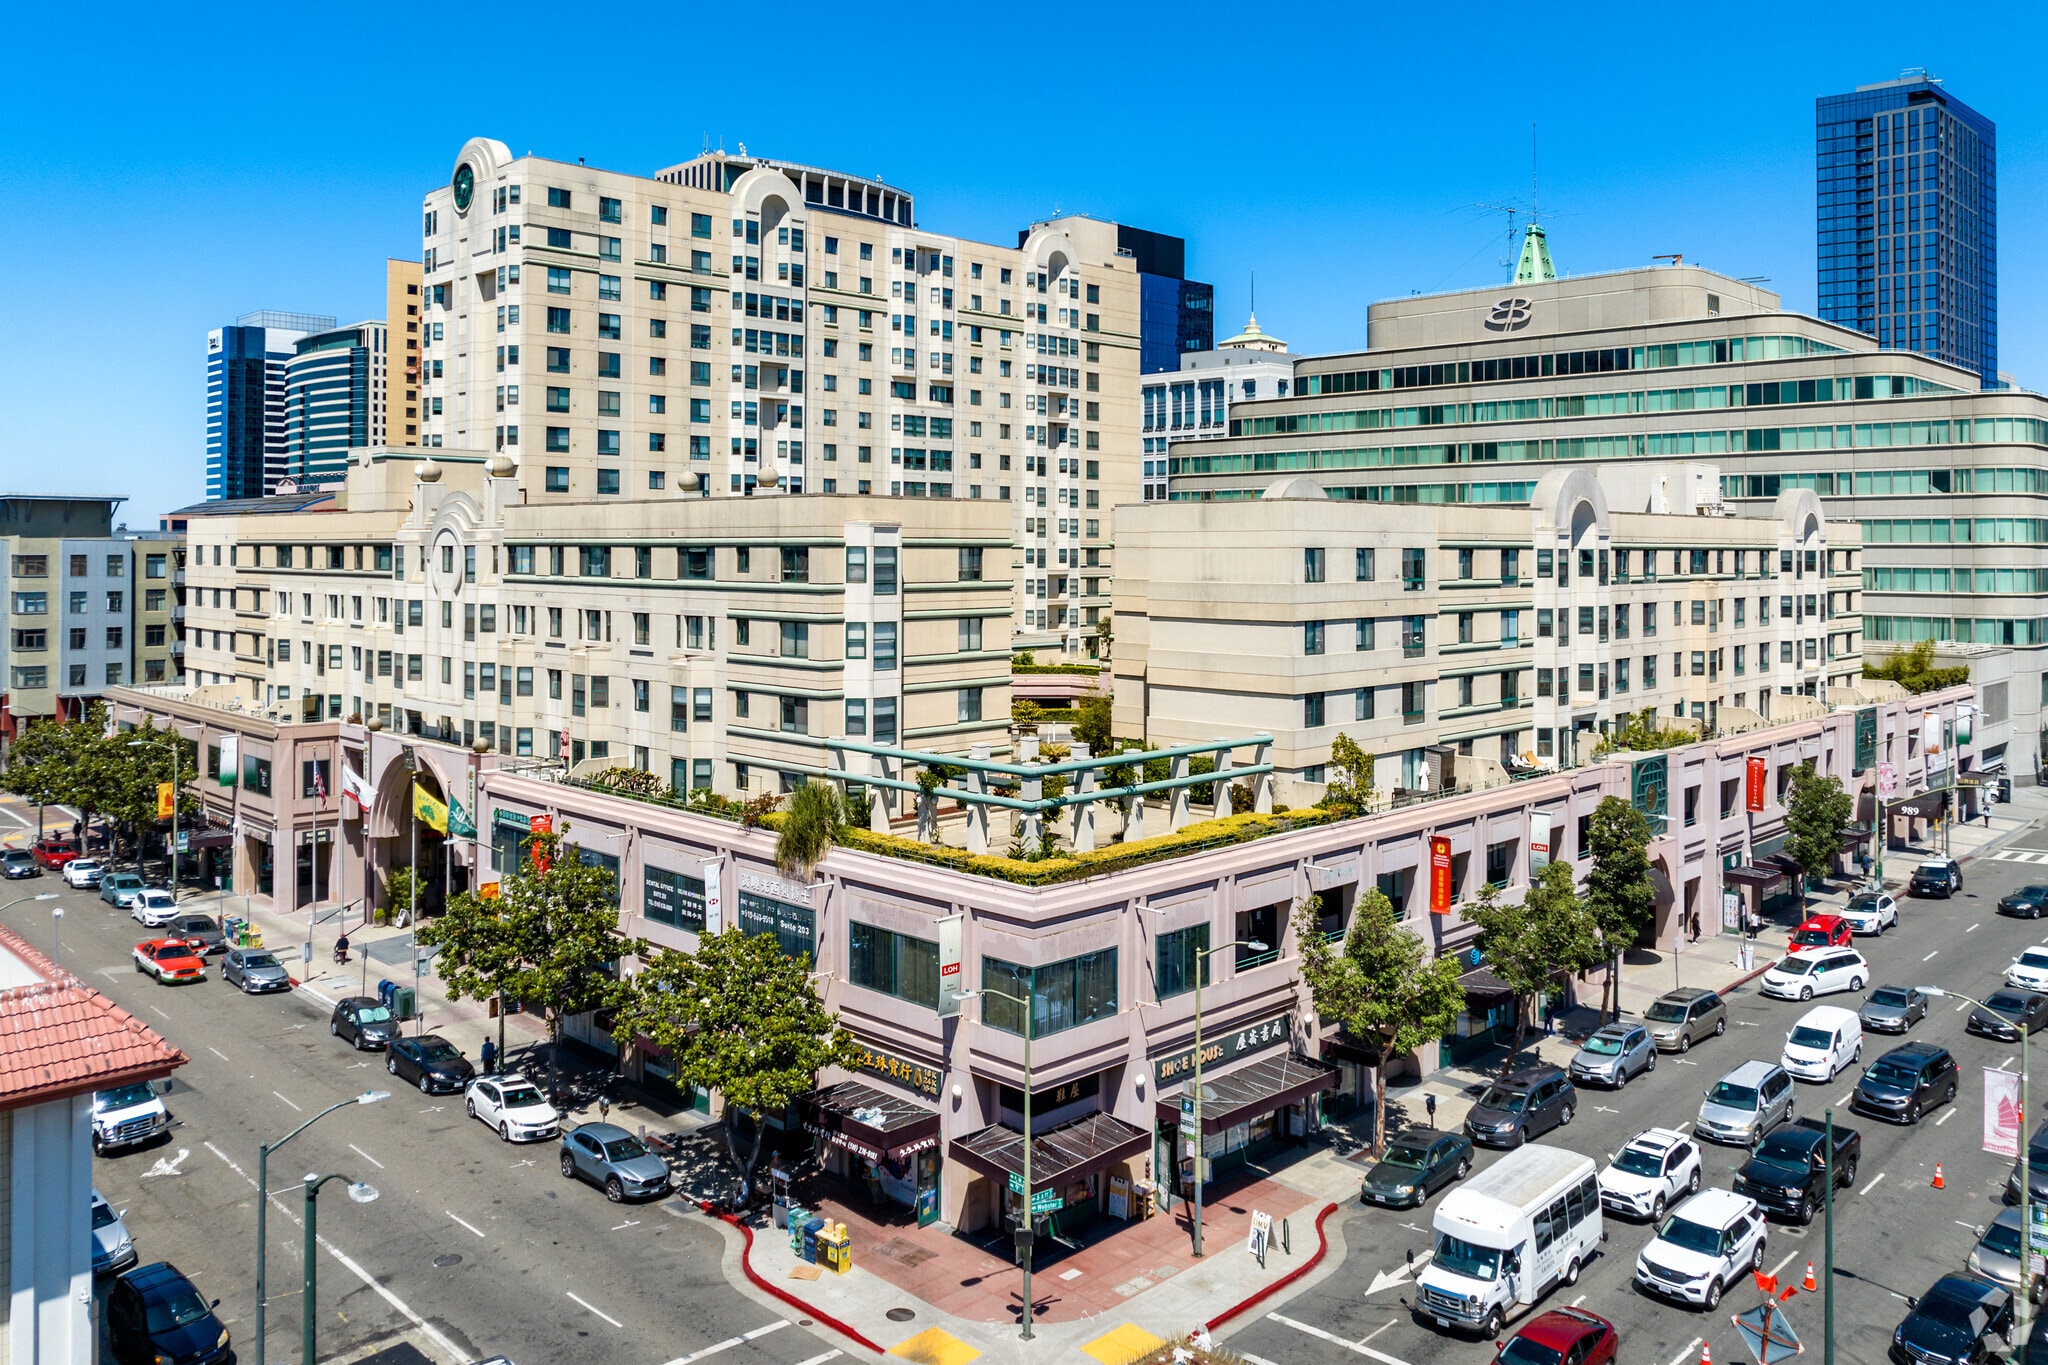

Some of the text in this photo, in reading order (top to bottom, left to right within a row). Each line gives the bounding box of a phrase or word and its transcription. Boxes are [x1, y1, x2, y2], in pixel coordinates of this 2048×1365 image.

[418, 794, 444, 814] OAKLAND
[1901, 805, 1919, 816] 989
[780, 920, 810, 936] Suite 203
[943, 964, 959, 975] LOH
[856, 1050, 913, 1082] 生珠寶行
[1161, 1055, 1189, 1079] SHOE
[1037, 1202, 1058, 1211] Webster
